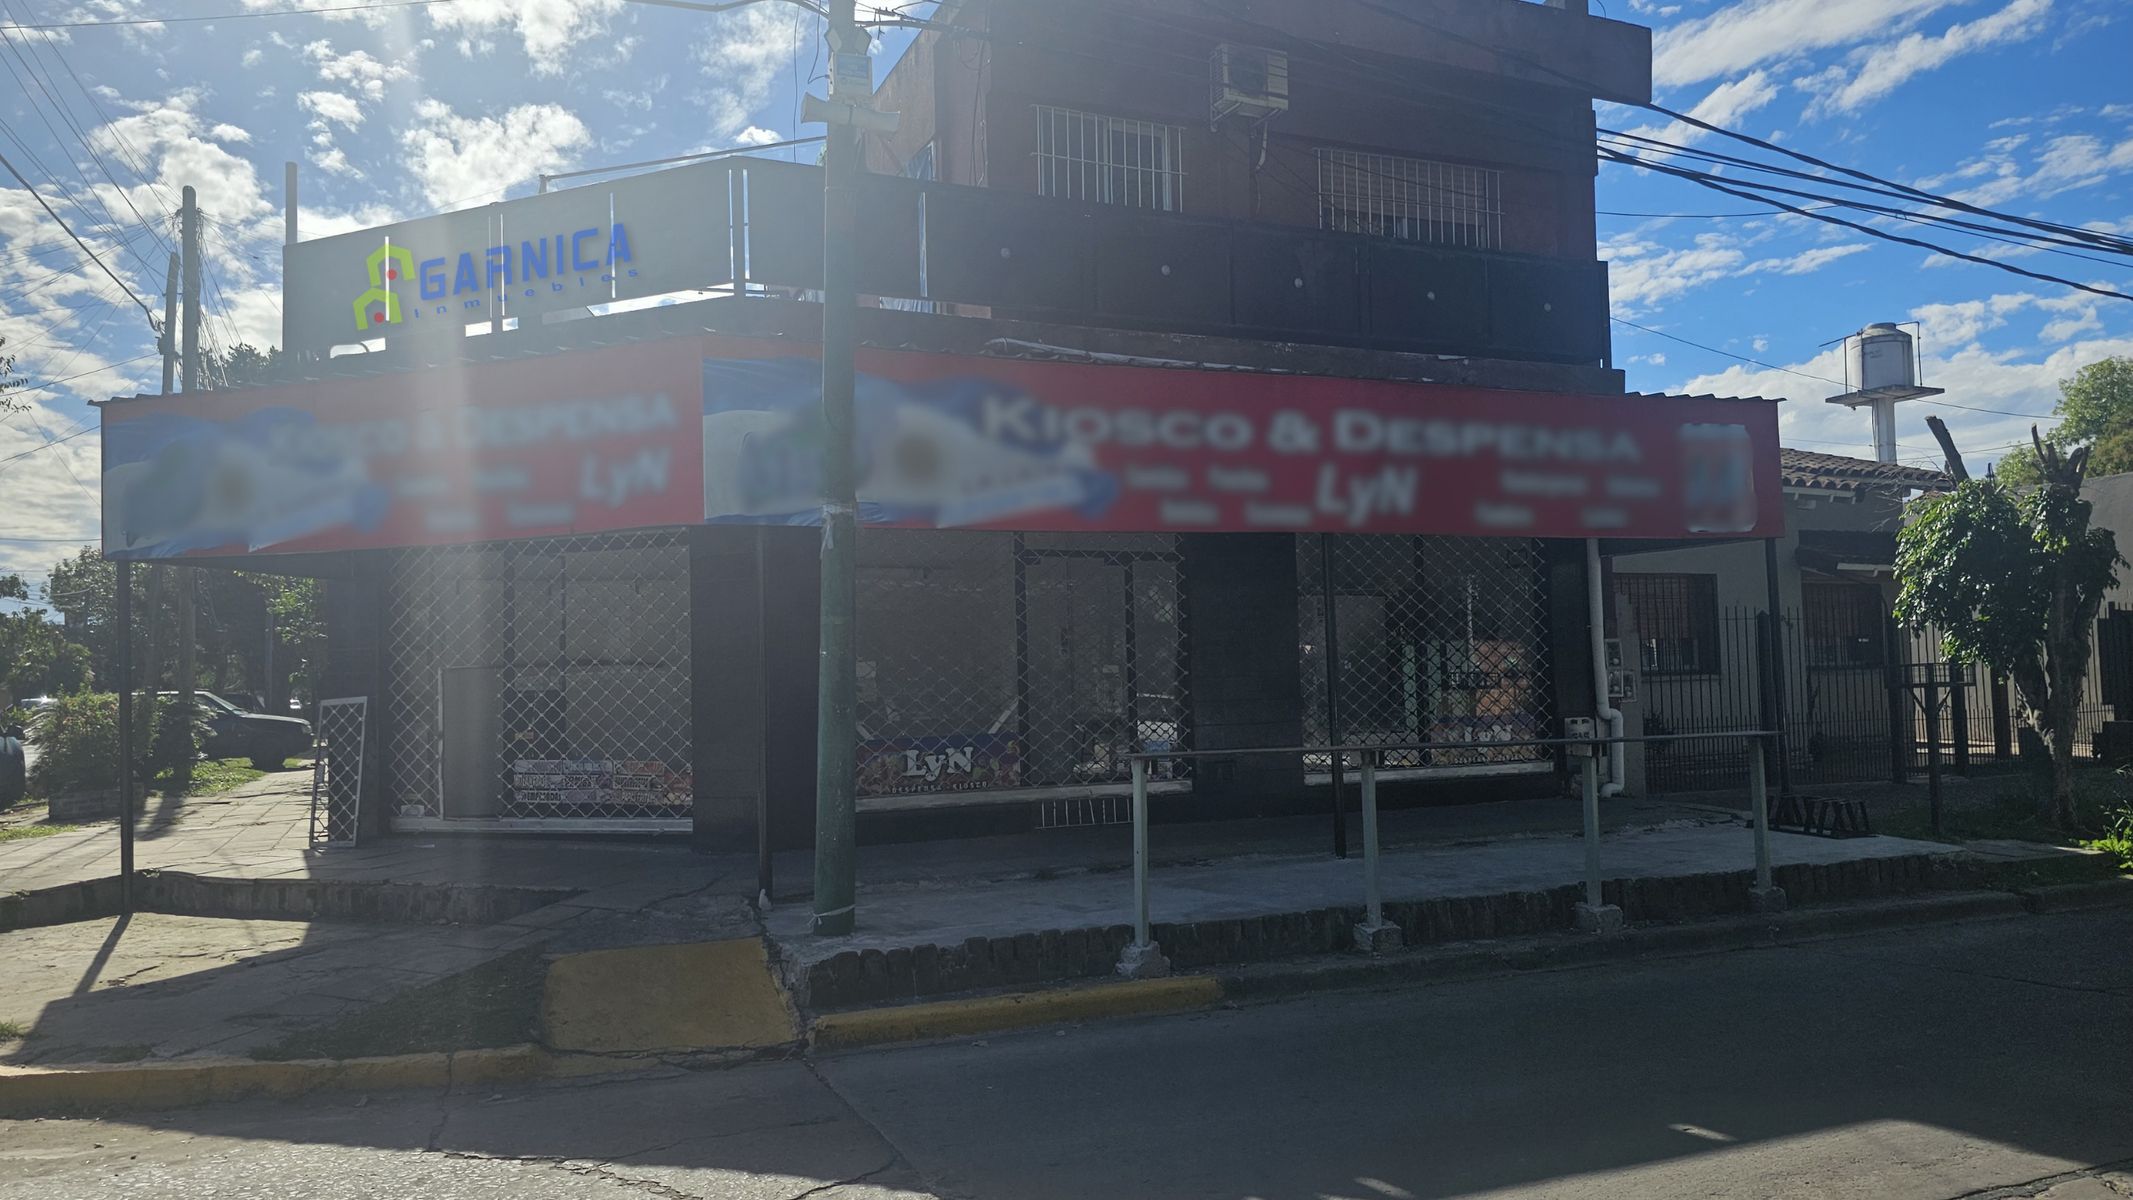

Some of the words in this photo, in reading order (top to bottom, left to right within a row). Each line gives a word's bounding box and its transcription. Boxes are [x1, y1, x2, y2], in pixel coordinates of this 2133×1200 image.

[419, 222, 633, 301] GARNICA
[982, 394, 1253, 453] KIOSCO
[1267, 408, 1319, 455] &
[1334, 408, 1643, 462] DESPENSA
[1315, 462, 1419, 526] LyN
[905, 747, 974, 781] LyN
